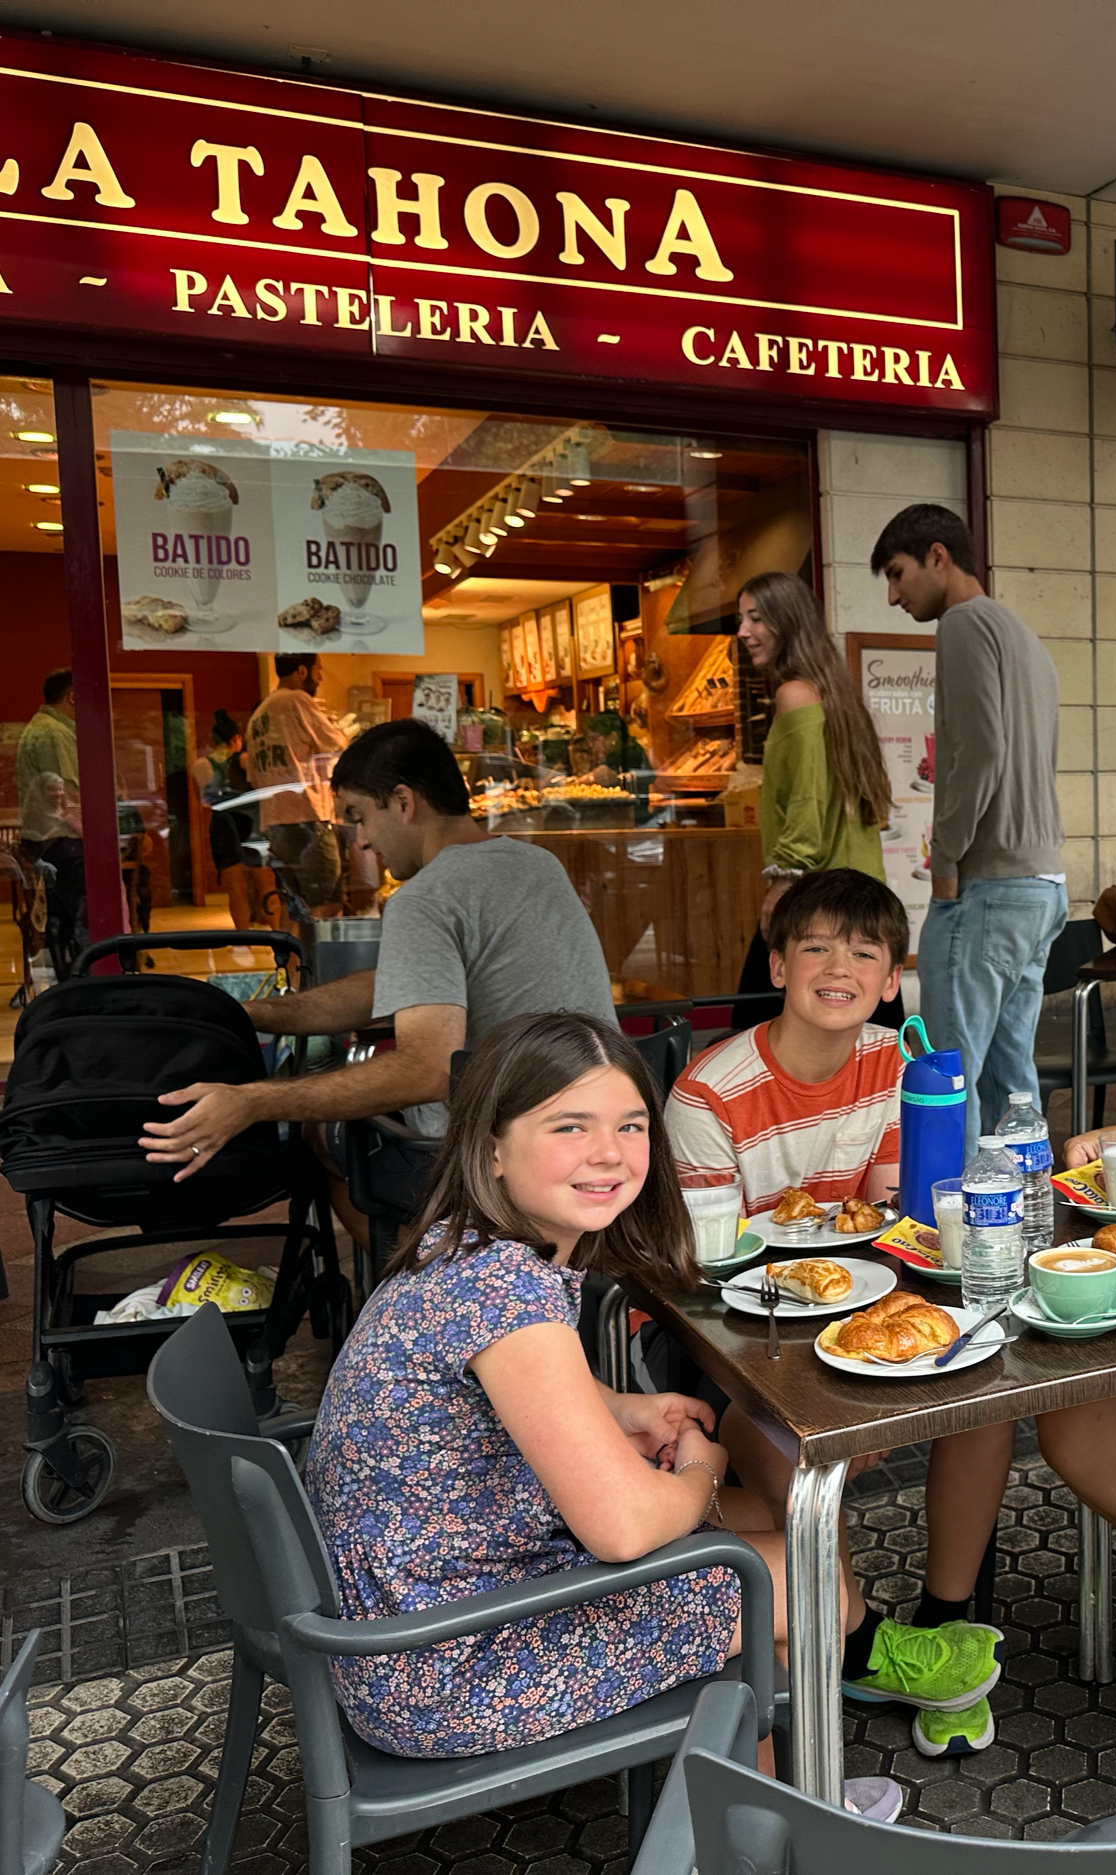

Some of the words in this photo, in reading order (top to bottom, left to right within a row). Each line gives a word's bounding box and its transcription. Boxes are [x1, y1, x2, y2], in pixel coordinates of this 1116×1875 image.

[0, 122, 136, 209] A
[190, 138, 734, 282] TAHONA
[169, 268, 560, 351] PASTELERIA
[681, 325, 966, 391] CAFETERIA
[151, 532, 250, 567] BATIDO
[306, 539, 397, 572] BATIDO
[153, 566, 190, 578] COOKIE
[192, 567, 206, 579] DE
[207, 567, 251, 580] COLORES
[308, 572, 341, 584] COOKIE
[343, 573, 396, 586] CHOCOLATE
[870, 698, 923, 715] FRUTA
[970, 1196, 1007, 1206] ELEONORE
